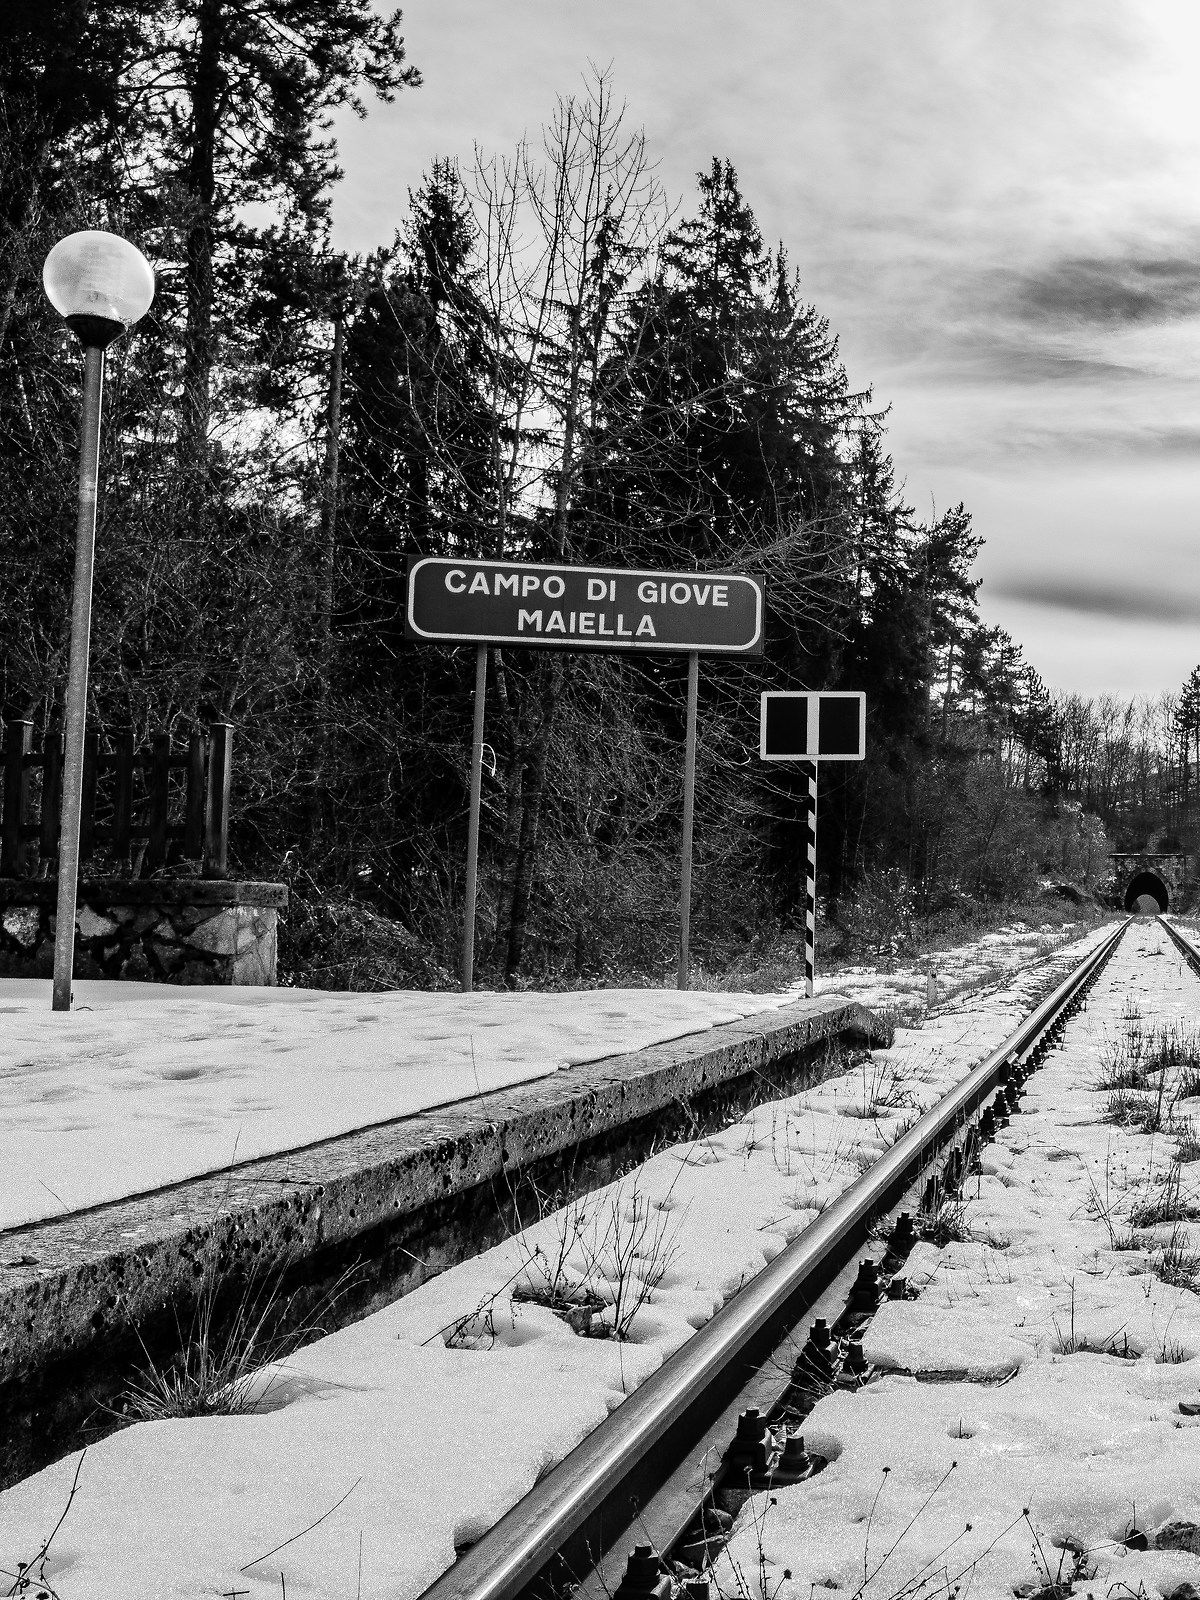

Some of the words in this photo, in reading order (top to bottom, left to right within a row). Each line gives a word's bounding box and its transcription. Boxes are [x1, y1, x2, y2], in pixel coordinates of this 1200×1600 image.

[444, 569, 567, 599] CAMPO
[587, 578, 617, 602] DI
[637, 580, 729, 607] GIOVE
[517, 608, 657, 637] MAIELLA
